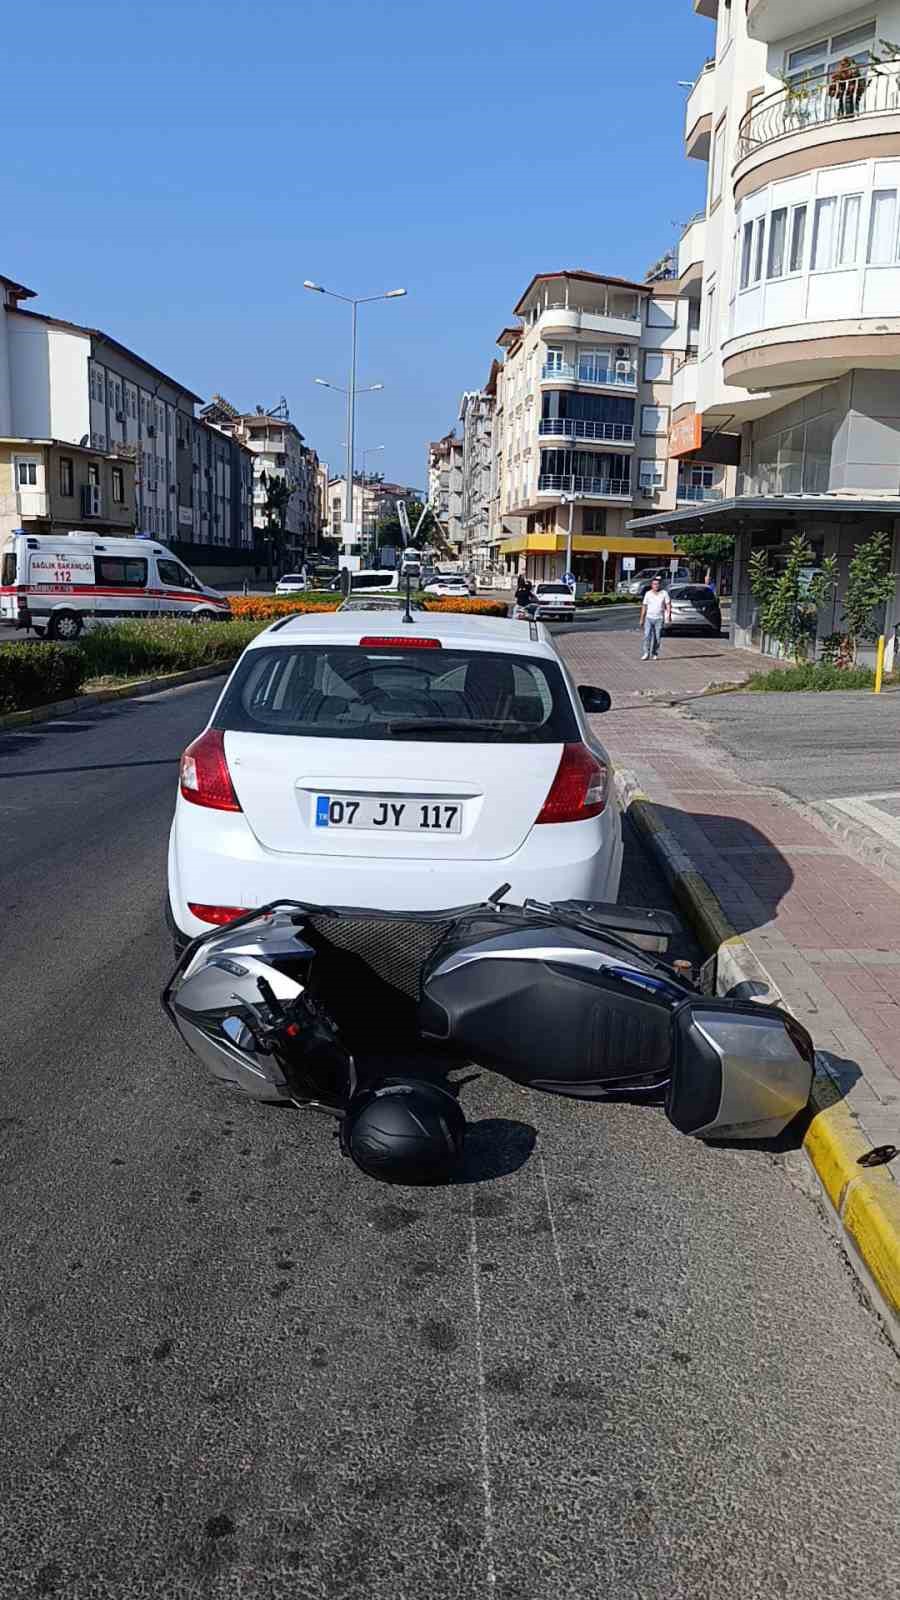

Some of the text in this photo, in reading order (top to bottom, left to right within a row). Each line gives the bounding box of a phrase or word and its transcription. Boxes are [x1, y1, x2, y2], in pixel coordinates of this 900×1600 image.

[32, 561, 92, 570] SAĞLIK BAKANLIĞI
[54, 571, 71, 582] 112
[329, 801, 458, 829] 07 JY 117
